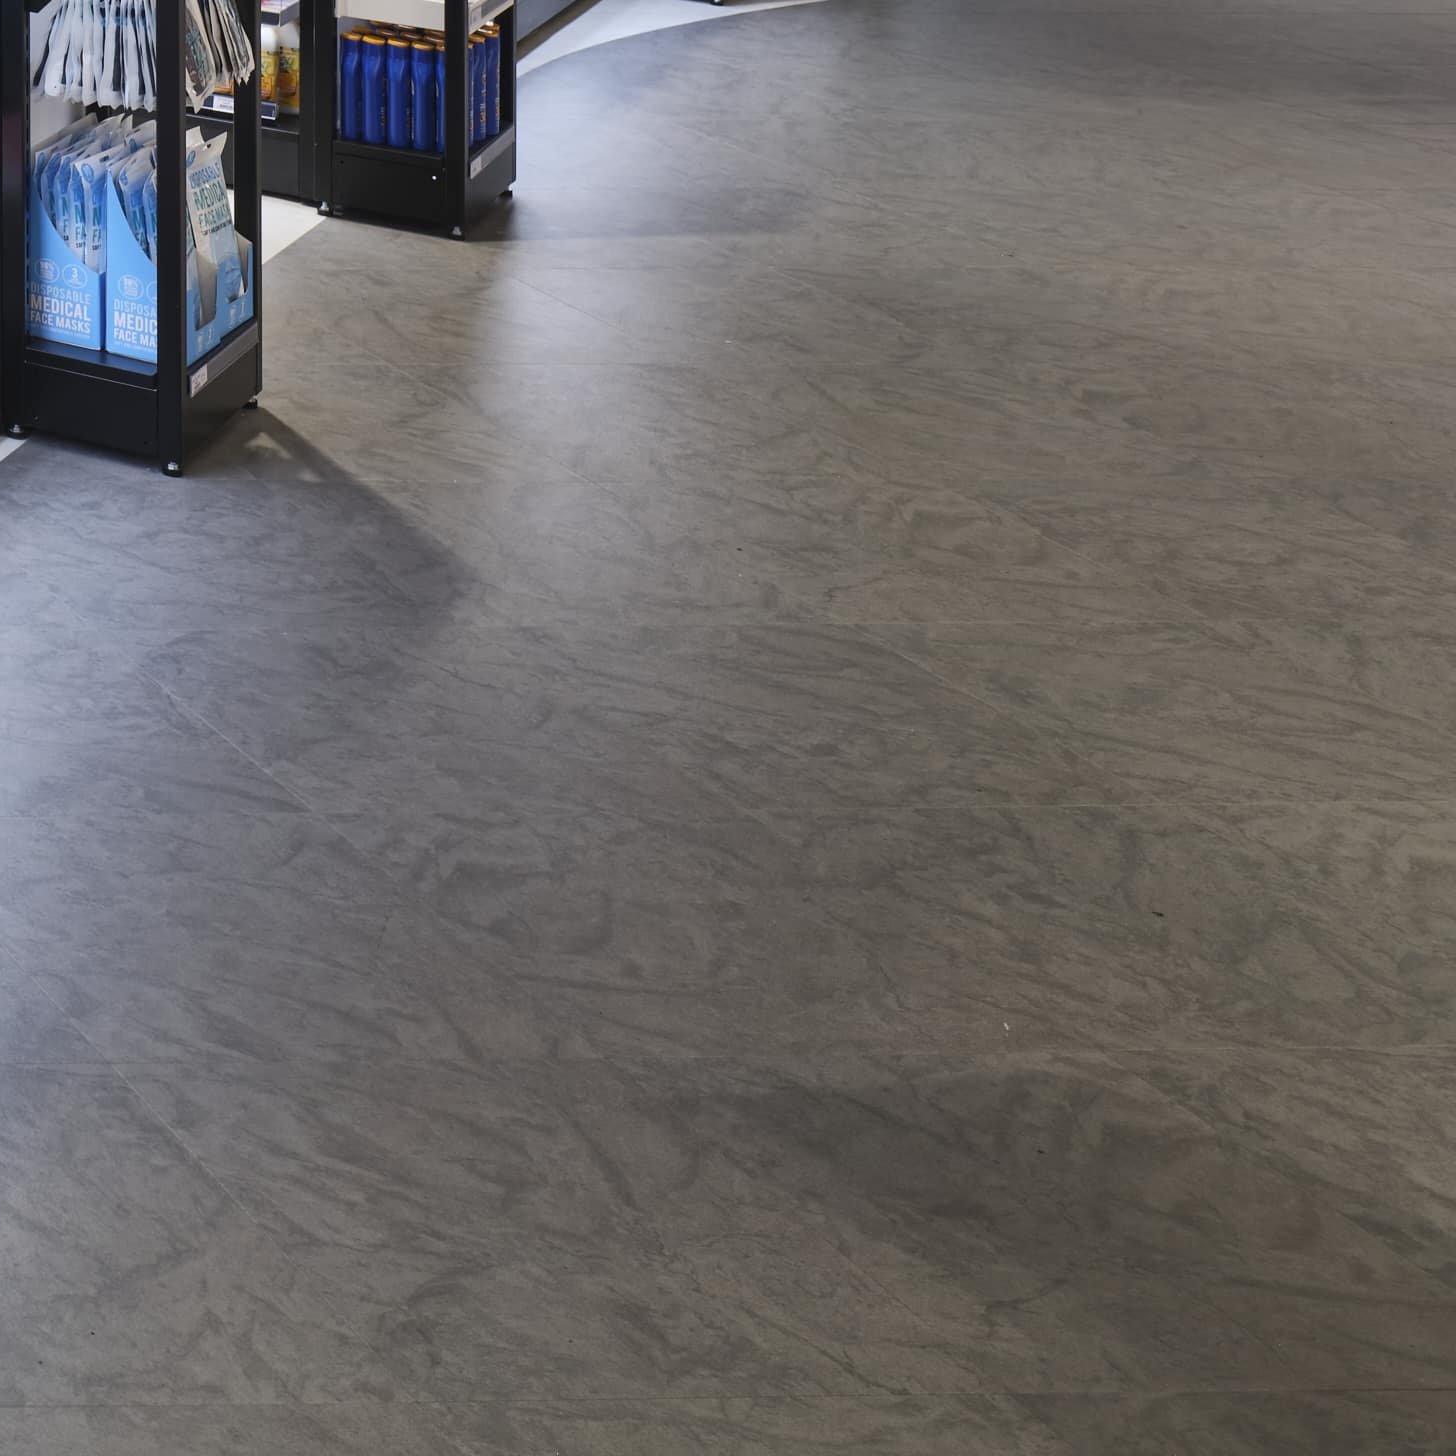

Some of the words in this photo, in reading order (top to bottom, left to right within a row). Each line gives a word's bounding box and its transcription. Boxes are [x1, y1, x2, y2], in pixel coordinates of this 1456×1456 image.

[31, 293, 91, 322] MEDICAL
[30, 310, 54, 326] FACE
[55, 314, 91, 334] MASKS
